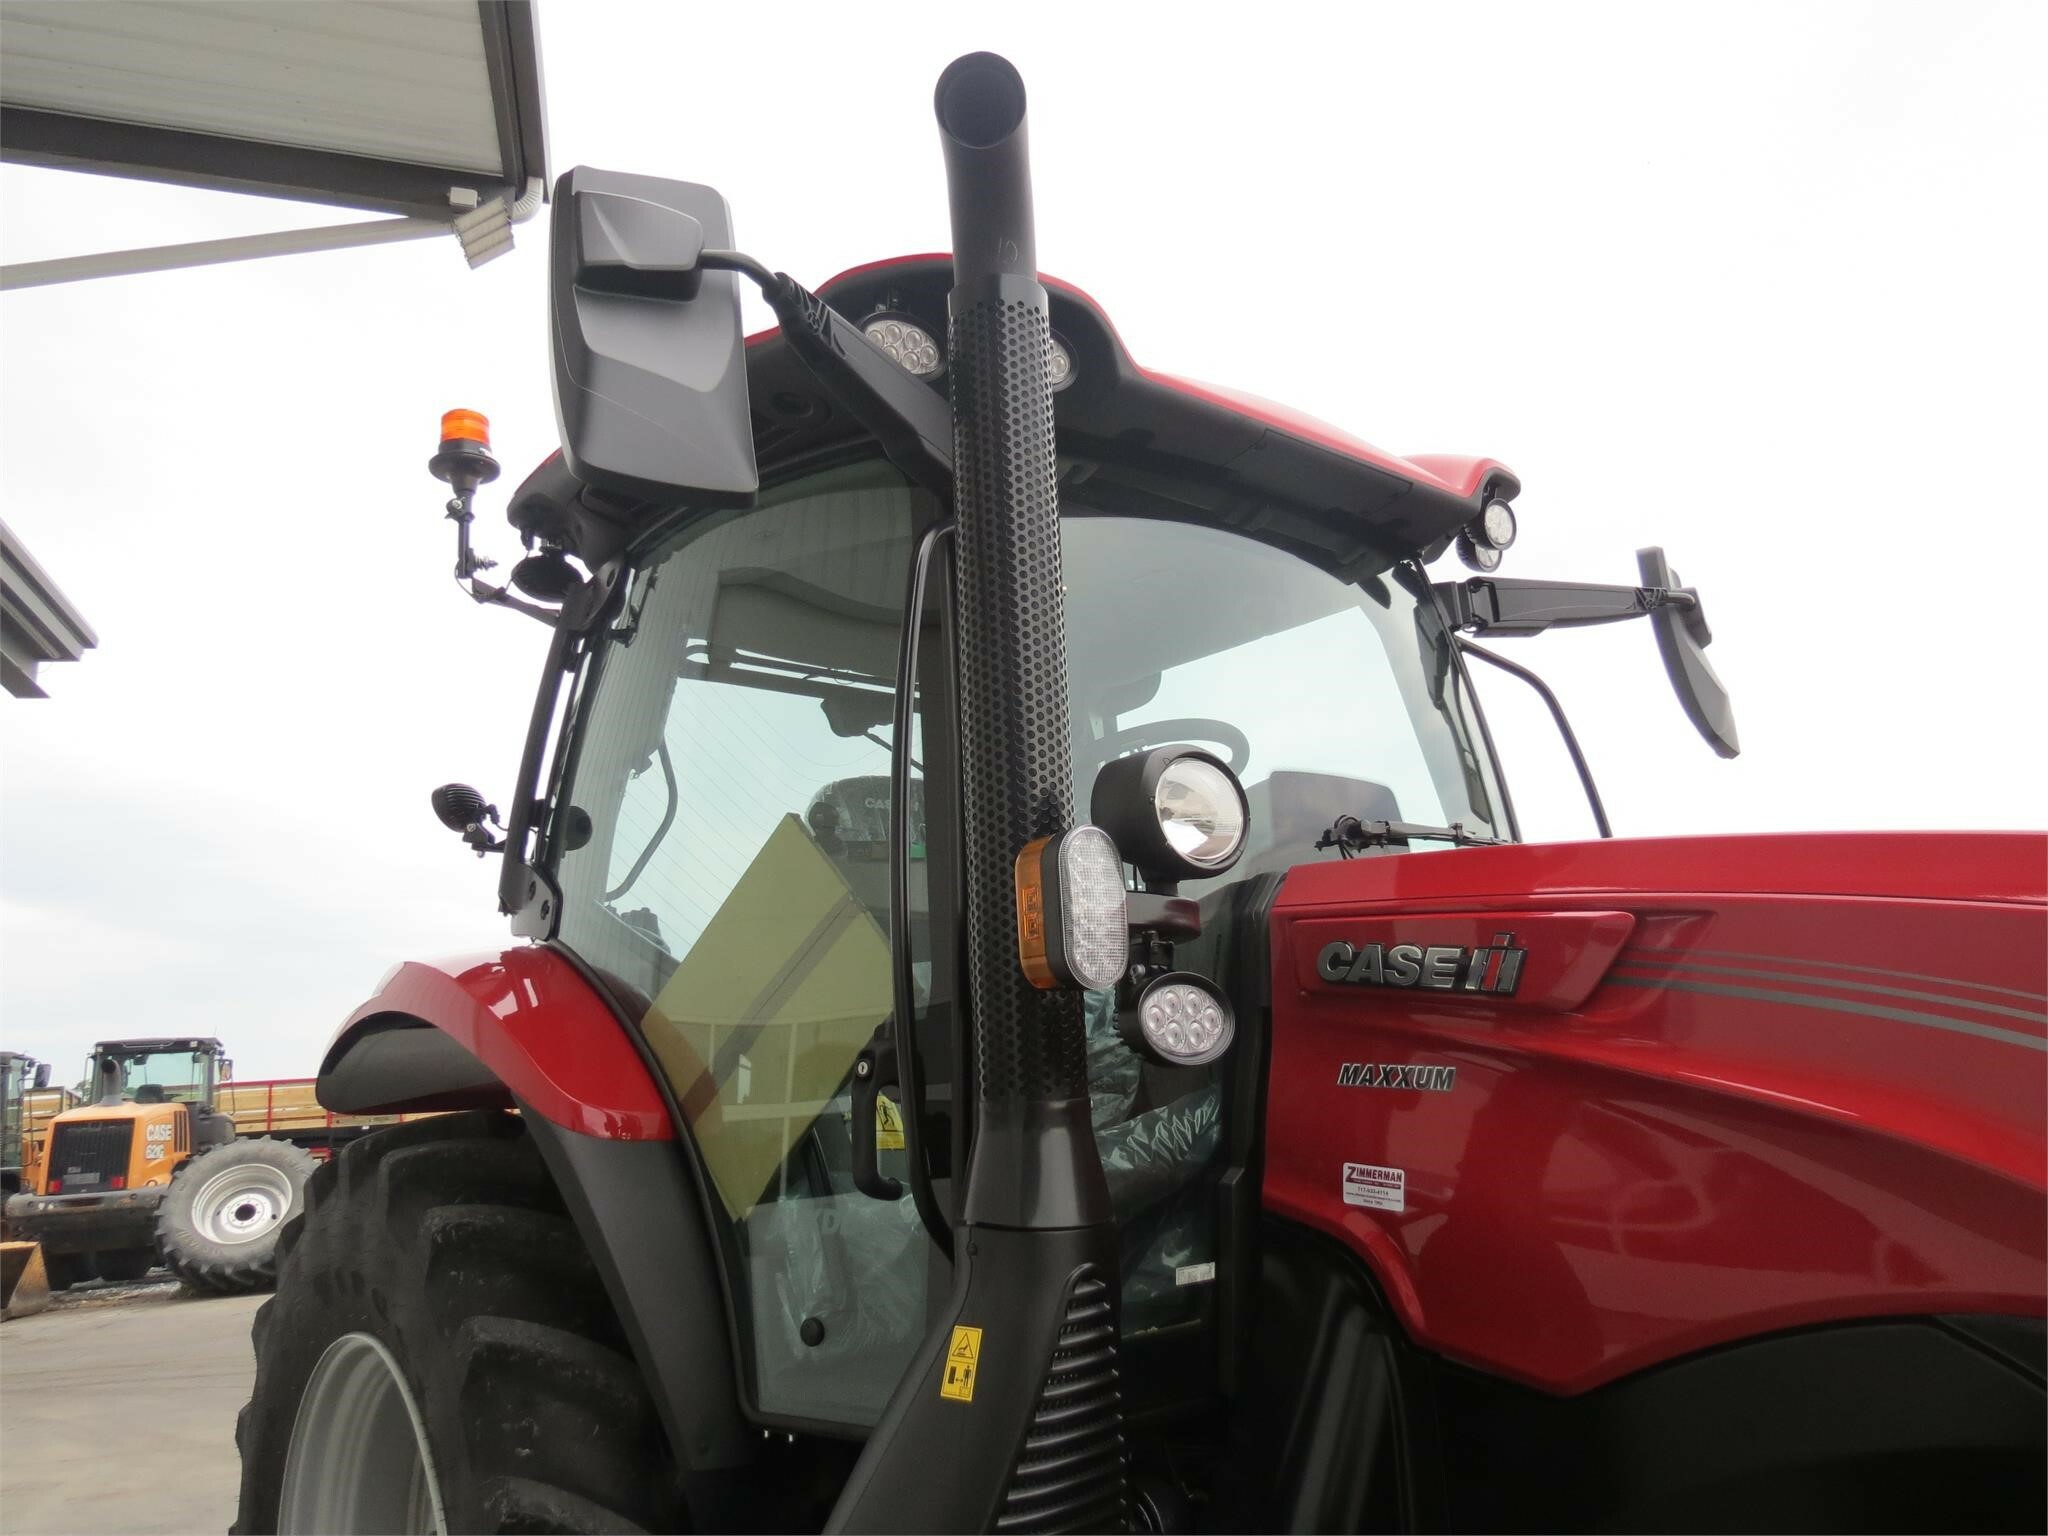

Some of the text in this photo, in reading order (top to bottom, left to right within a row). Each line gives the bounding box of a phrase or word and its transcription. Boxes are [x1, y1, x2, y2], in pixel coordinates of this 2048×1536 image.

[1317, 941, 1463, 989] CASE
[1337, 1063, 1457, 1092] MAXXUM
[146, 1123, 172, 1141] CASE
[1346, 1166, 1402, 1182] ZIMMERMAN
